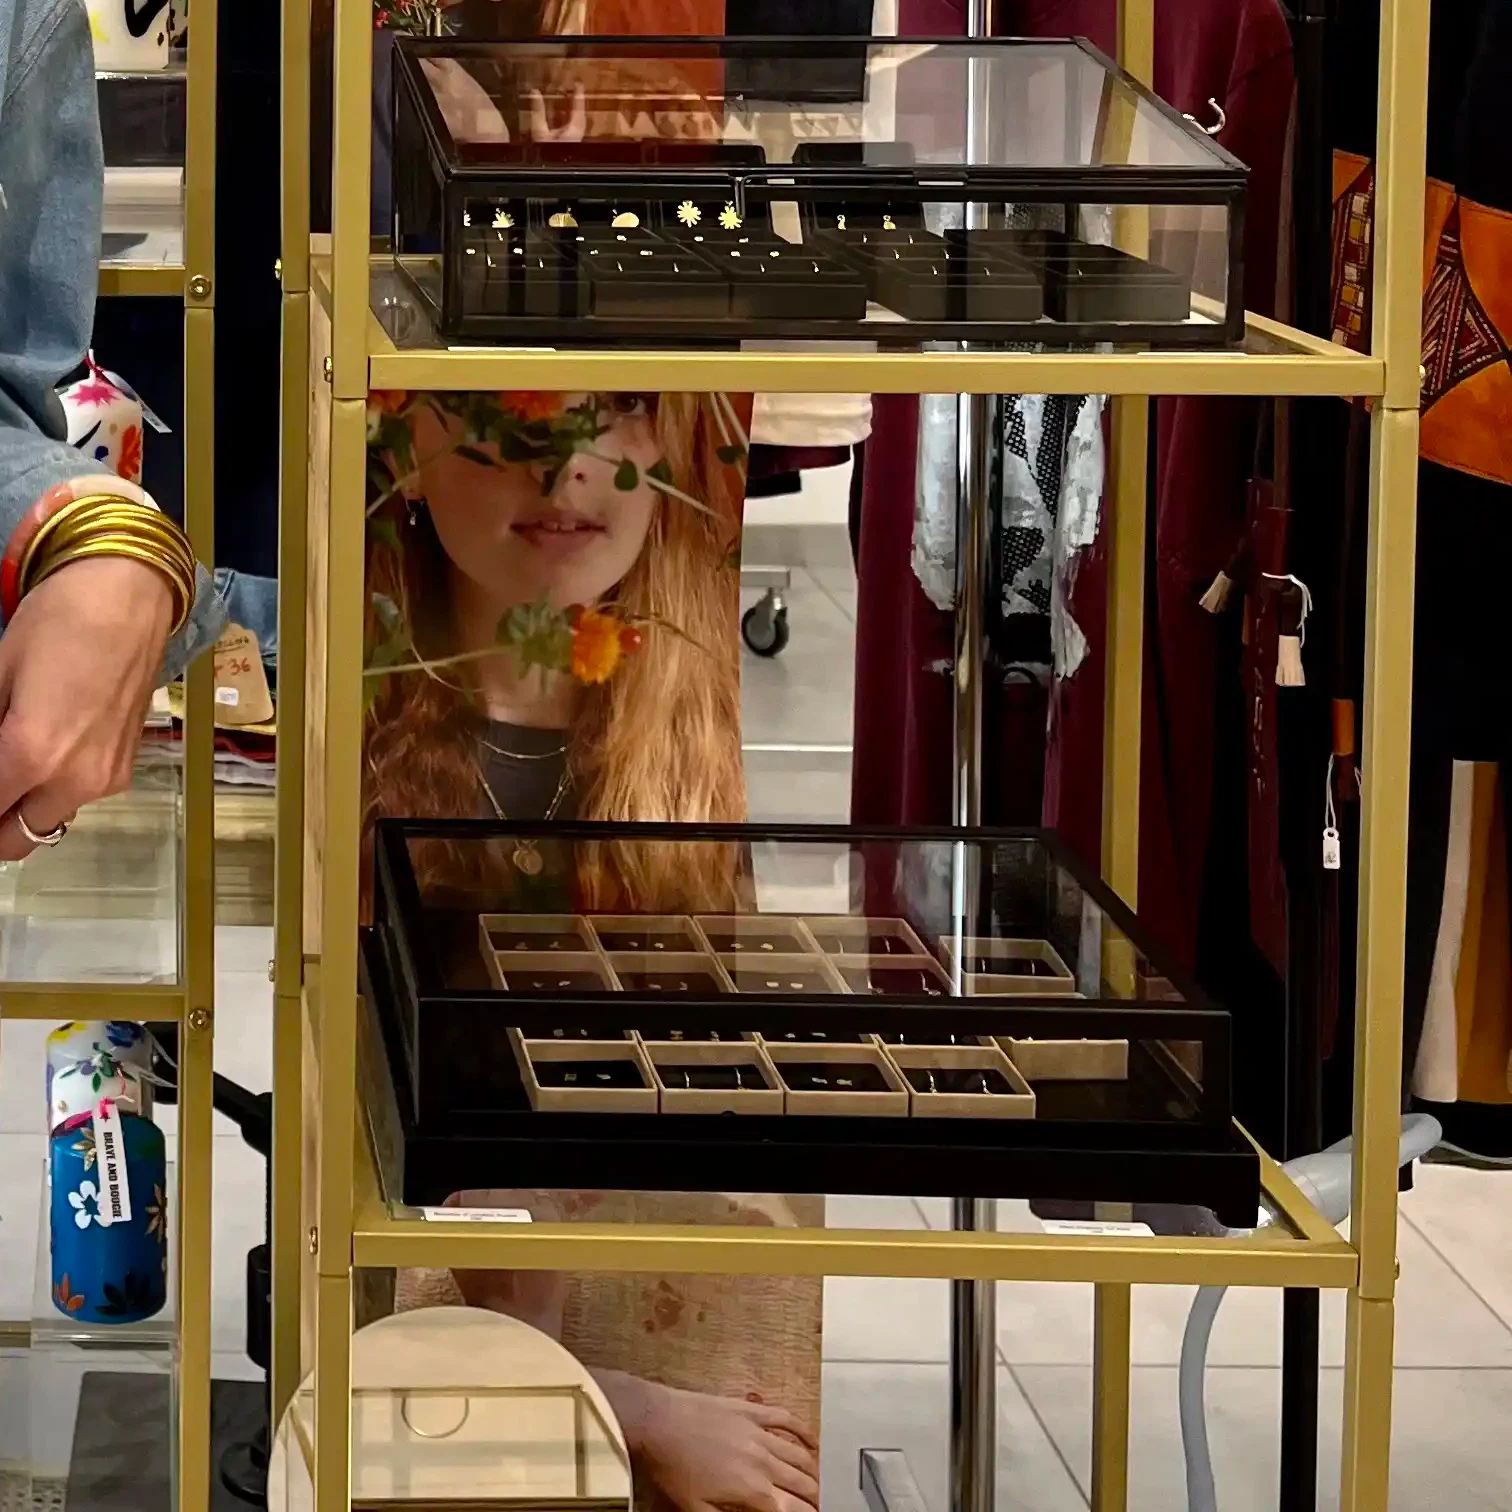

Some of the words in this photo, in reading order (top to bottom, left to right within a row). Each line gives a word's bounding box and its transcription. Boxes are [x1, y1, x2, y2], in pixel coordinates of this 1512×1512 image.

[103, 1131, 116, 1161] BRAVE
[107, 1162, 118, 1182] AND
[109, 1184, 122, 1218] BOUGIE
